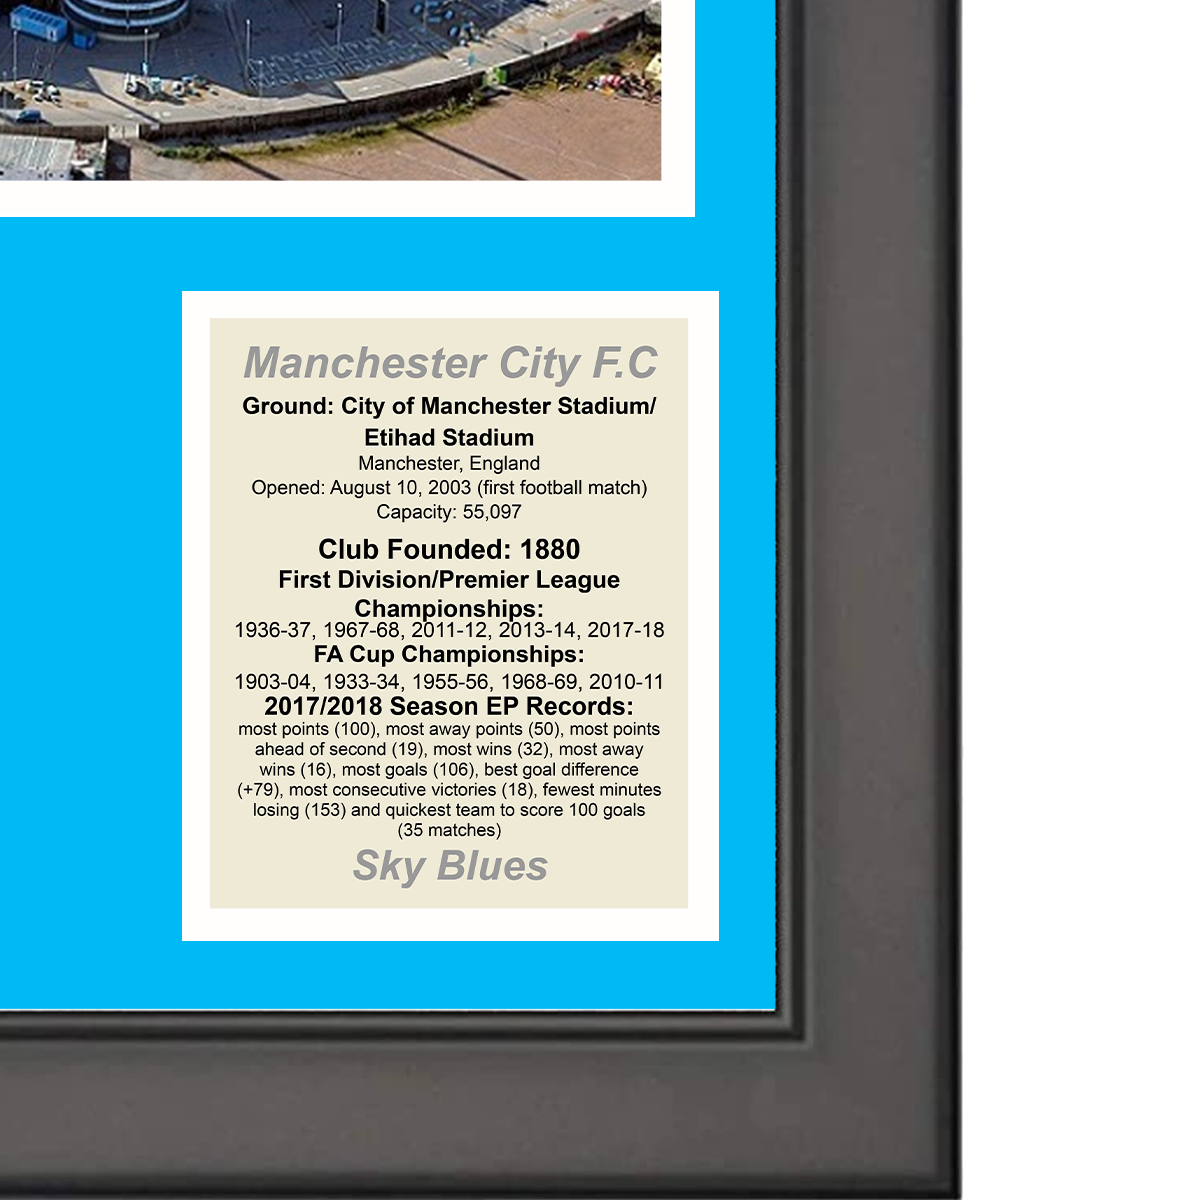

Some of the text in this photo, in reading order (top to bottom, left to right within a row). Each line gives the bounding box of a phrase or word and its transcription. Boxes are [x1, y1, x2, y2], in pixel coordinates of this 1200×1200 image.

[243, 345, 659, 388] Manchester City F.C
[242, 395, 658, 420] Ground: City of Manchester Stadium/
[364, 427, 534, 447] Etihad Stadium
[358, 454, 541, 475] Manchester, England
[251, 478, 648, 500] Opened: August 10, 2003 (first football match)
[376, 503, 523, 524] Capacity: 55,097
[318, 537, 581, 560] Club Founded: 1880
[279, 569, 621, 594] First Division/Premier League
[354, 598, 544, 624] Championships:
[235, 621, 665, 642] 1936-37, 1967-68, 2011-12, 2013-14, 2017-18
[314, 644, 584, 668] FA Cup Championships:
[235, 672, 662, 693] 1903-04, 1933-34, 1955-56, 1968-69, 2010-11
[264, 695, 633, 716] 2017/2018 Season EP Records:
[238, 721, 661, 740] most points (100), most away points (50), most points
[254, 741, 645, 760] ahead of second (19), most wins (32), most away
[258, 761, 640, 780] wins (16), most goals (106), best goal difference
[237, 781, 662, 801] (+79), most consecutive victories (18), fewest minutes
[253, 801, 646, 821] losing (153) and quickest team to score 100 goals
[397, 822, 502, 841] (35 matches)
[352, 848, 549, 889] Sky Blues
